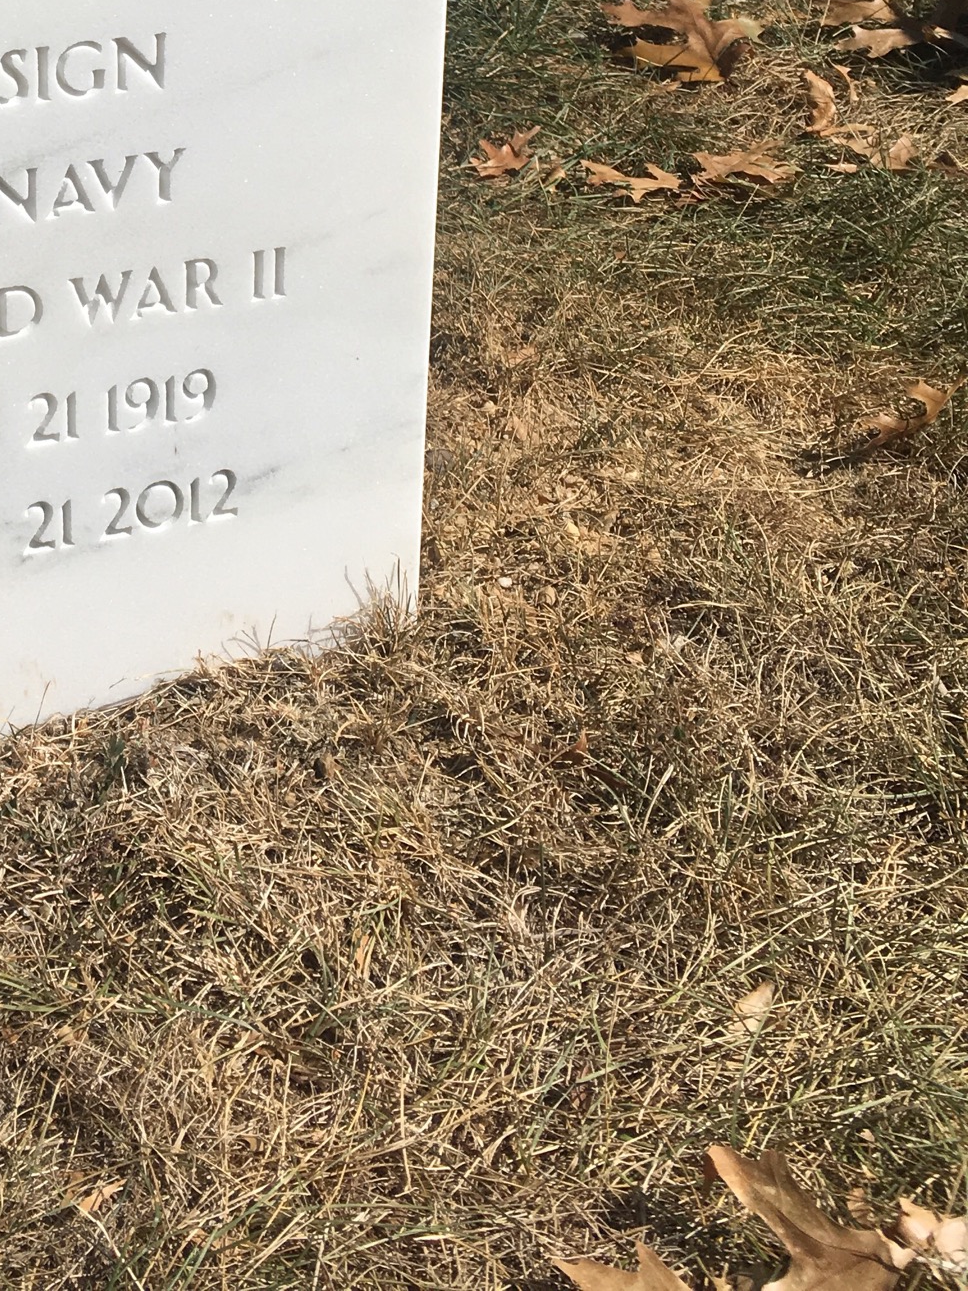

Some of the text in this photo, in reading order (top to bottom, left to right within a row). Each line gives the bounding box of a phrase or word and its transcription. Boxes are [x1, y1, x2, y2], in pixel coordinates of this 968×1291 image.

[68, 258, 223, 327] WAR
[251, 247, 286, 299] II
[28, 390, 80, 443] 21
[106, 368, 217, 433] 1919
[24, 498, 75, 555] 21
[100, 468, 238, 541] 2012
